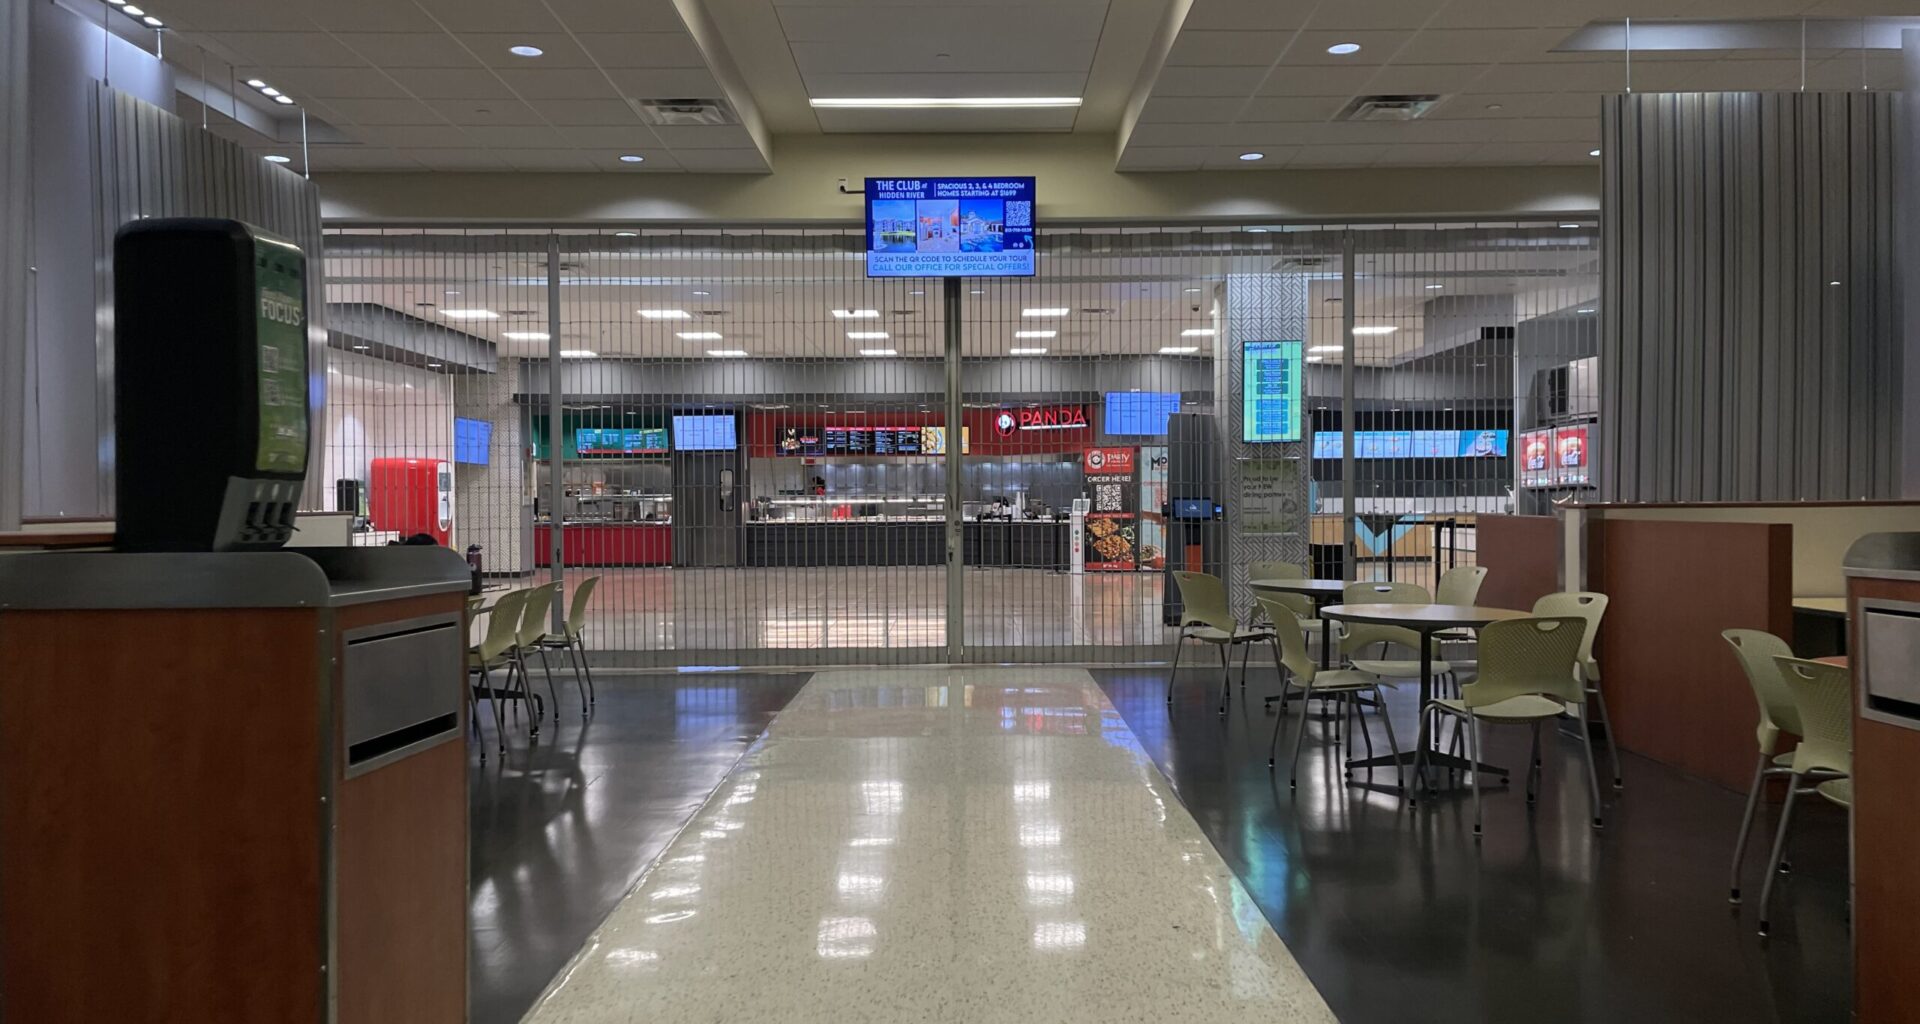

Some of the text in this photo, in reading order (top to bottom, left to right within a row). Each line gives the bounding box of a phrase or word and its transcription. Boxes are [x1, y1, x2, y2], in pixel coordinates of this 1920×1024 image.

[876, 180, 895, 190] THE
[896, 180, 921, 190] CLUB
[879, 191, 925, 199] HIDDEN RIVER
[962, 263, 995, 271] SPECIAL
[261, 298, 300, 326] FOCUS
[1020, 409, 1086, 425] PANDA
